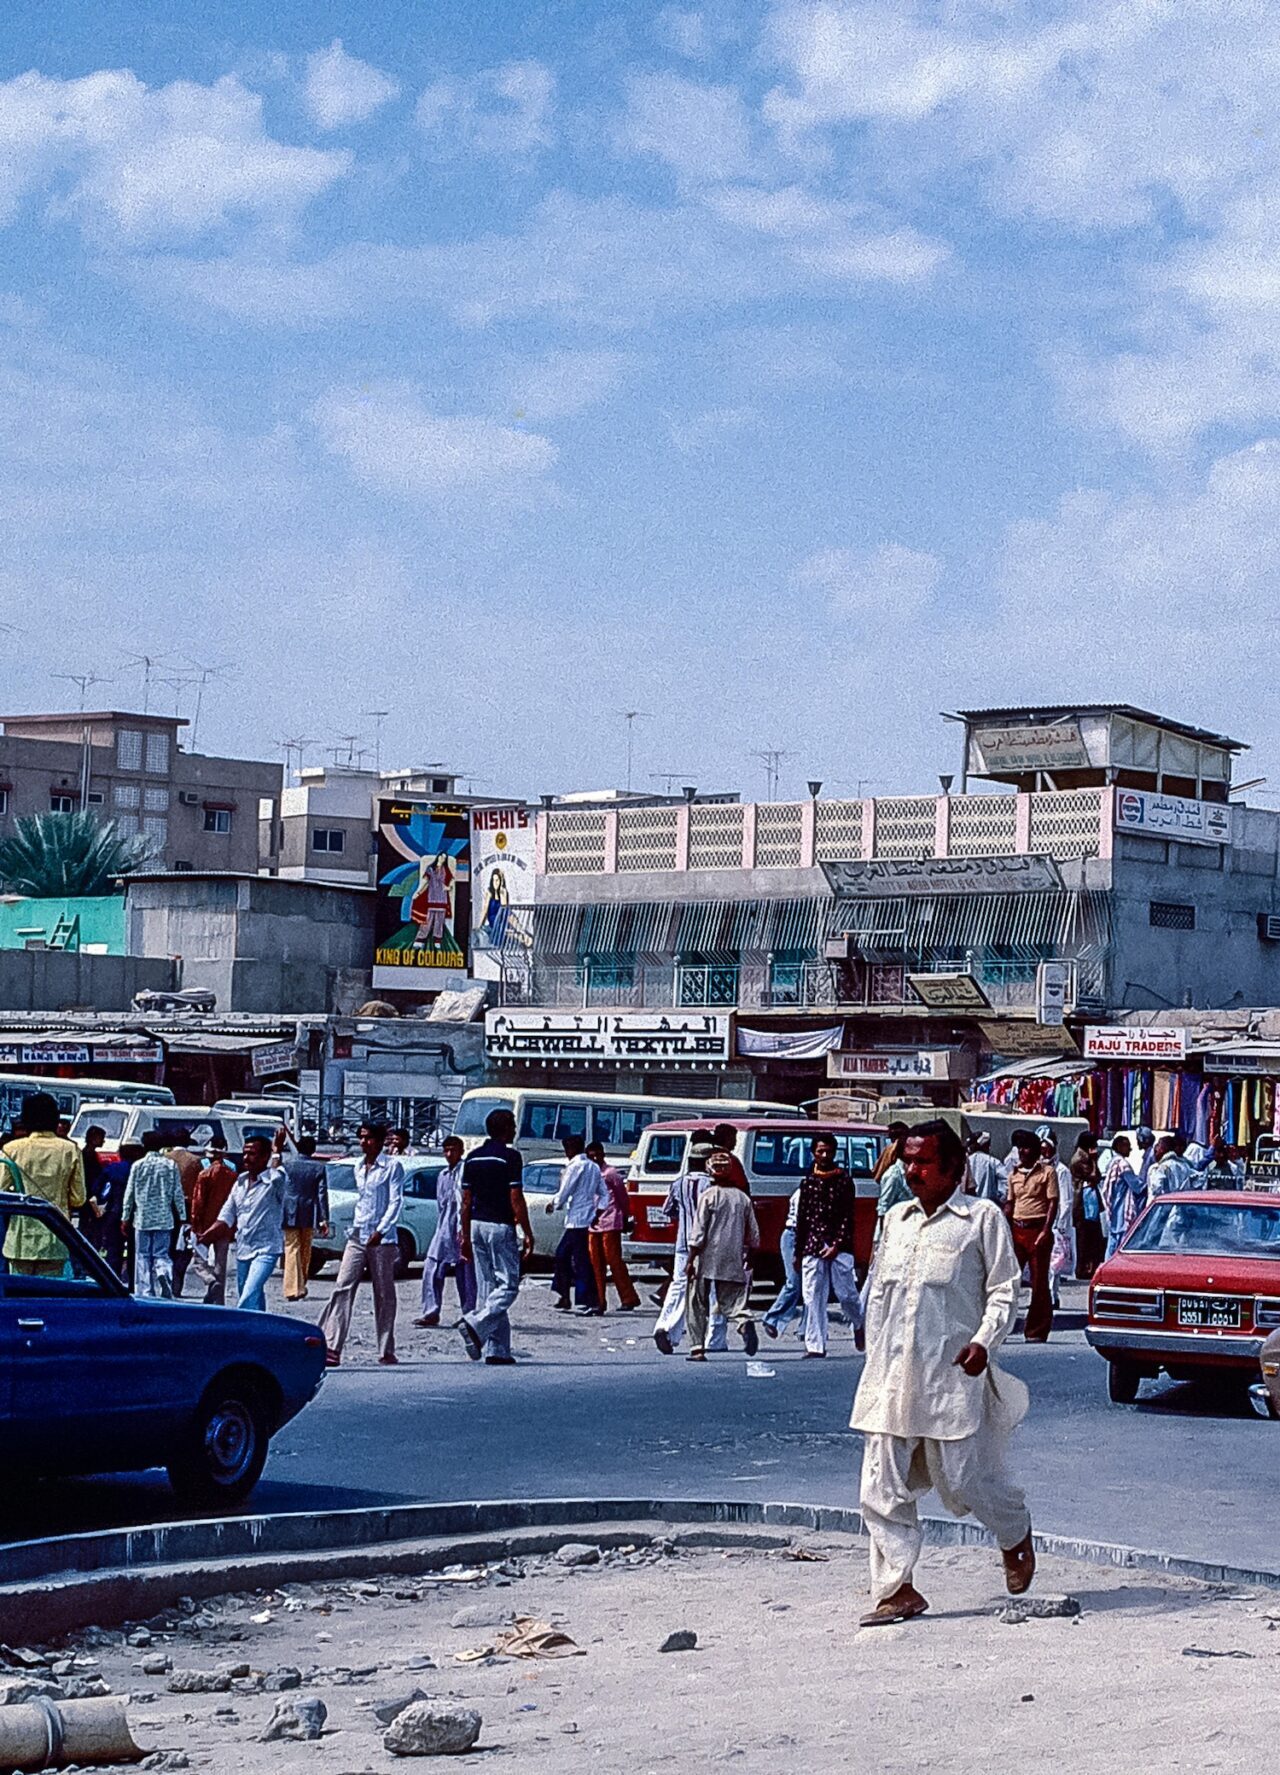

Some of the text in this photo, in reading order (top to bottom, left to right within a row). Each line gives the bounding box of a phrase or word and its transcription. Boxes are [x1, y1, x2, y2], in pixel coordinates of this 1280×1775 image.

[472, 808, 529, 831] NISHI'S
[376, 948, 464, 967] KING OF COLOURS
[486, 1035, 725, 1053] PACEWELL TEXTILES
[1088, 1040, 1182, 1052] RAJU TRADERS
[860, 1058, 888, 1074] TRADERS
[1250, 1165, 1279, 1176] TAXI
